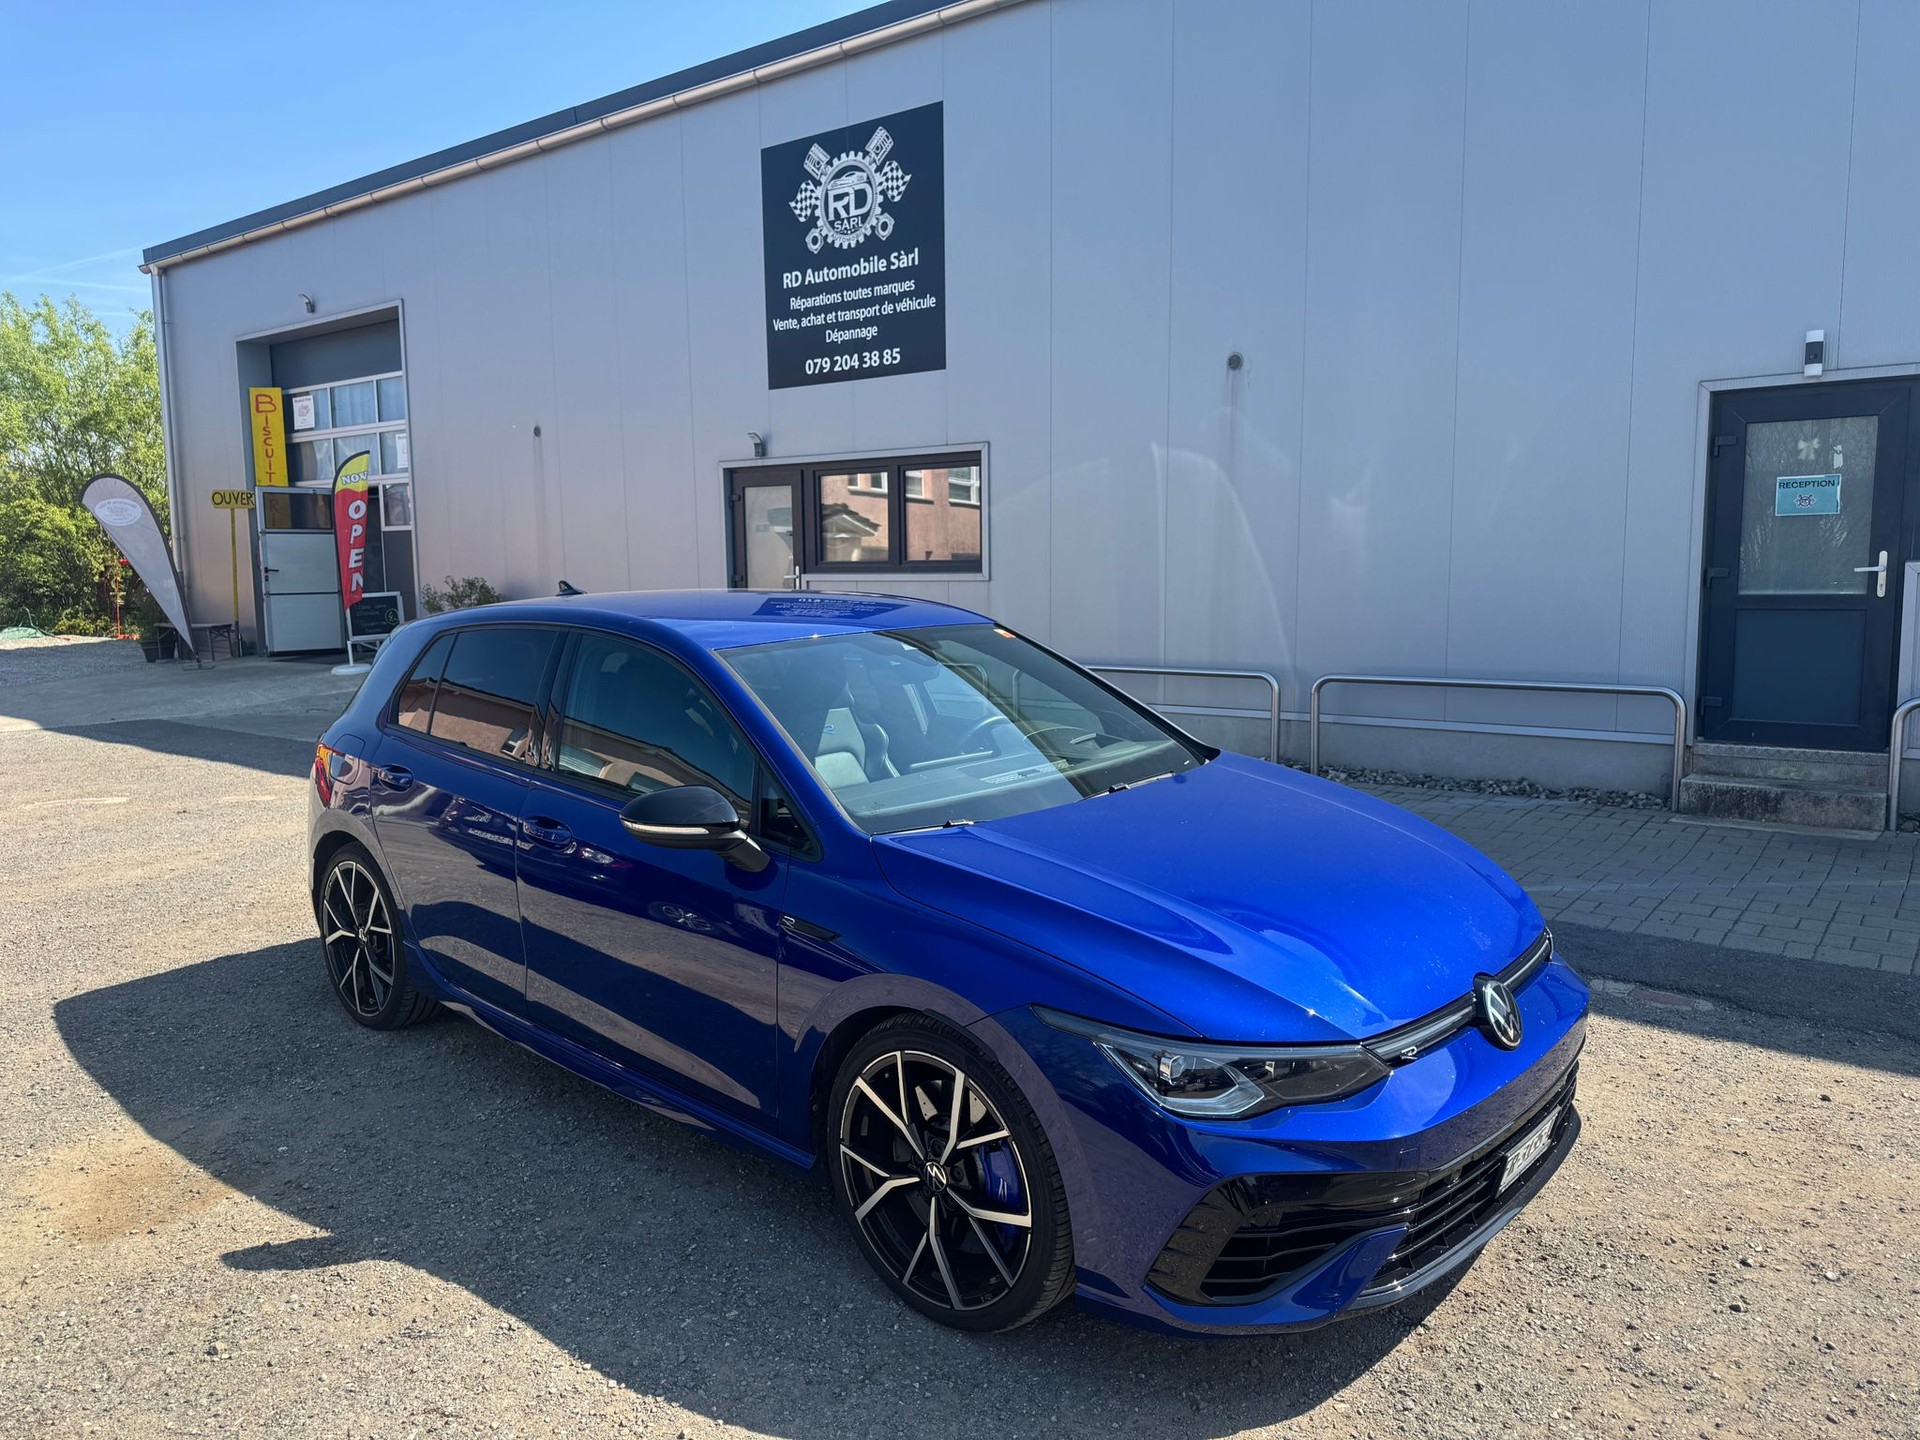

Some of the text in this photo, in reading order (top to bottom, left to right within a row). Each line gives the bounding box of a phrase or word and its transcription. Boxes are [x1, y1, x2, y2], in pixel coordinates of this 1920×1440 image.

[828, 183, 873, 221] RD
[783, 248, 919, 288] RD Automobile Sàrl
[790, 280, 915, 311] Réparations toutes marques
[773, 294, 937, 331] Vente, achat et transport de véhicule
[825, 325, 878, 344] Dépannage
[805, 348, 901, 375] 079 204 38 85
[212, 491, 255, 506] OUVER
[1778, 479, 1836, 489] RECEPTION
